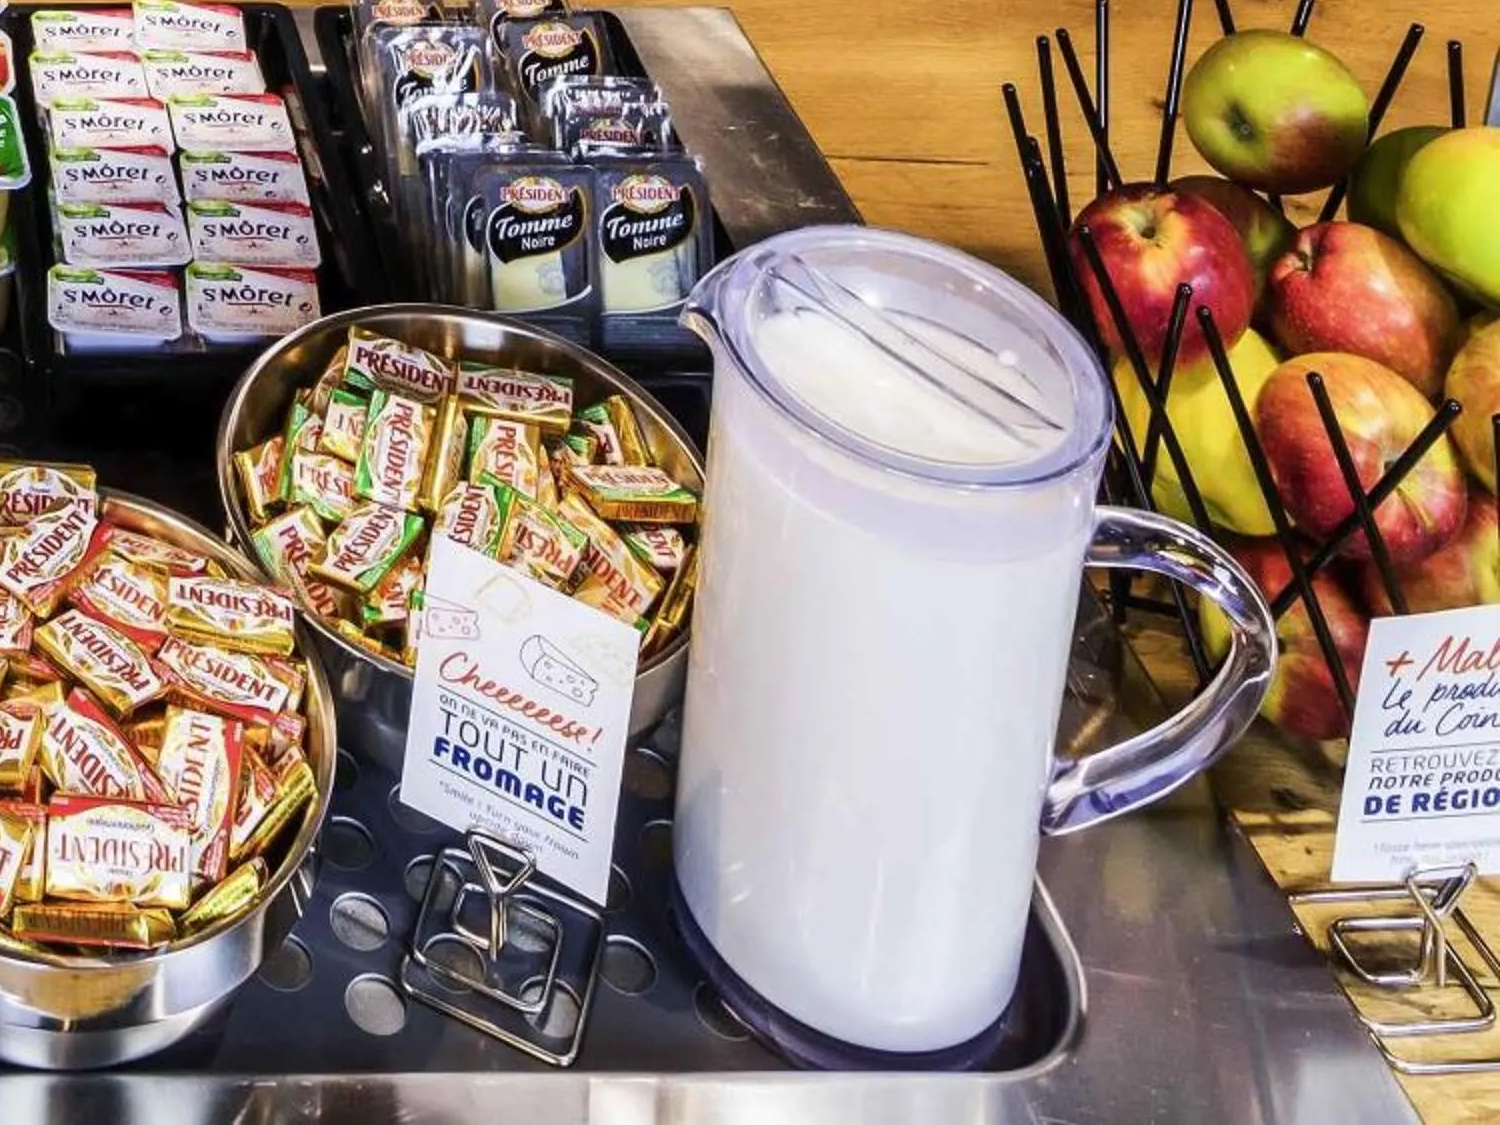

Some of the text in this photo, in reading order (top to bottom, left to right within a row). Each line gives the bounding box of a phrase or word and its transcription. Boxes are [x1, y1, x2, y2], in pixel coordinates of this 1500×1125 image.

[525, 54, 590, 86] Tomme
[501, 184, 572, 202] PRÉSIDENT
[611, 183, 682, 201] PRÉSIDENT
[495, 214, 574, 240] Tomme
[607, 212, 686, 240] Tomme
[521, 235, 556, 250] Noire
[632, 234, 667, 250] Noire
[354, 346, 457, 393] PRÉSIDENT
[465, 375, 571, 404] PRÉSIDENT
[5, 510, 88, 584] PRÉSIDENT
[178, 583, 292, 622] PRÉSIDENT
[59, 615, 151, 692] PRÉSIDENT
[164, 639, 278, 702] PRÉSIDENT
[1381, 677, 1414, 711] Le
[439, 694, 457, 710] ON
[502, 723, 528, 746] PAS
[1384, 711, 1426, 738] du
[440, 707, 588, 809] TOUT UN
[1370, 748, 1499, 775] RETROUVEZ
[434, 736, 586, 832] FROMAGE
[1368, 772, 1435, 791] NOTRE
[1363, 793, 1402, 817] DE
[58, 831, 189, 875] PRÉSIDENT
